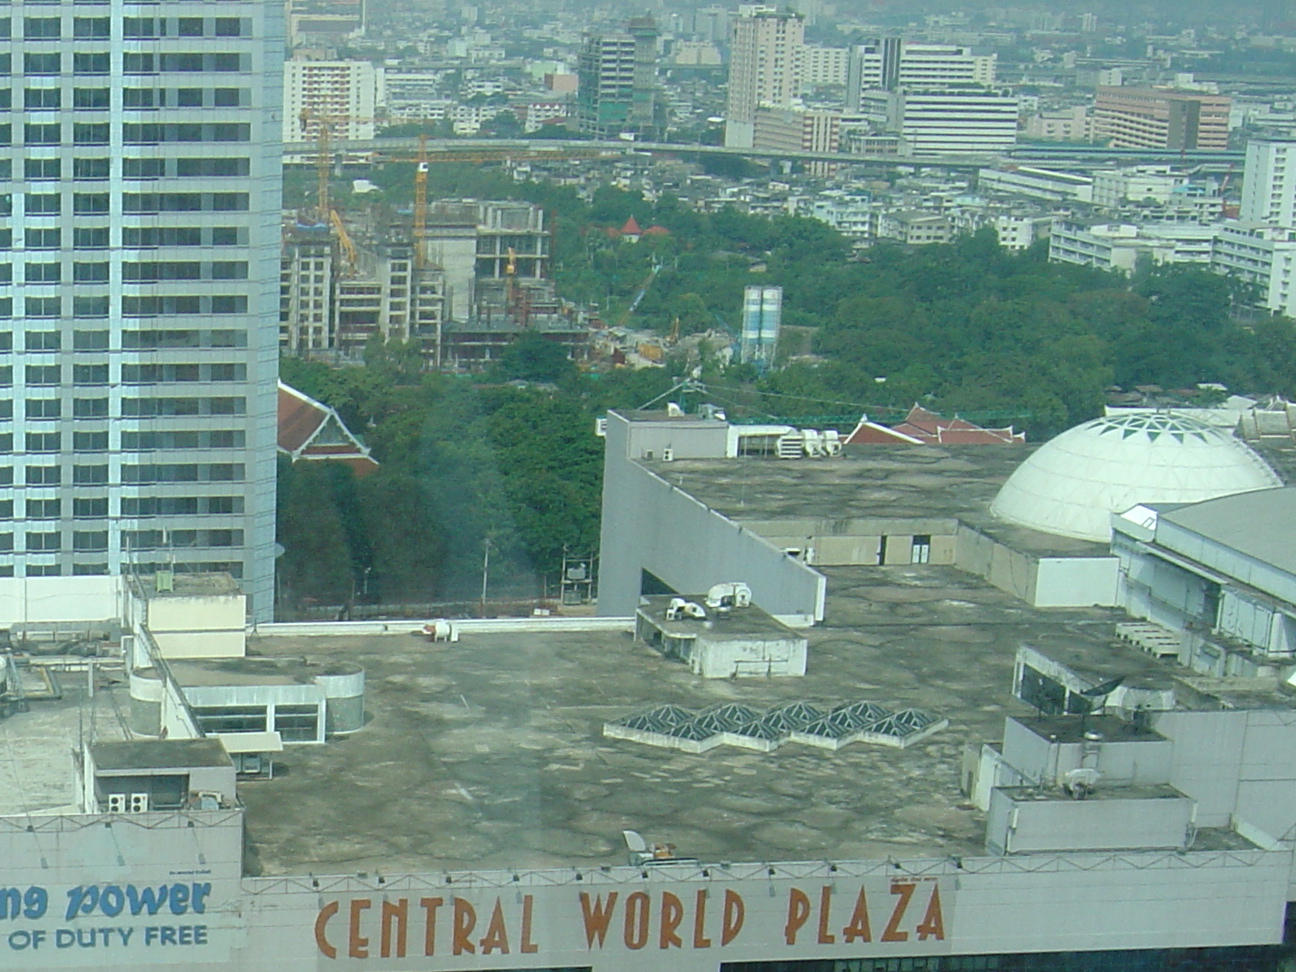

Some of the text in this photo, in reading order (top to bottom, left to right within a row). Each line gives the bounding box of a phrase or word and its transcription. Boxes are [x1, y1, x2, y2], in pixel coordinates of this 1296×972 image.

[8, 930, 46, 951] OF
[56, 927, 134, 949] DUTY
[145, 925, 208, 946] FREE
[315, 882, 946, 960] CENTRAL WORLD PLAZA
